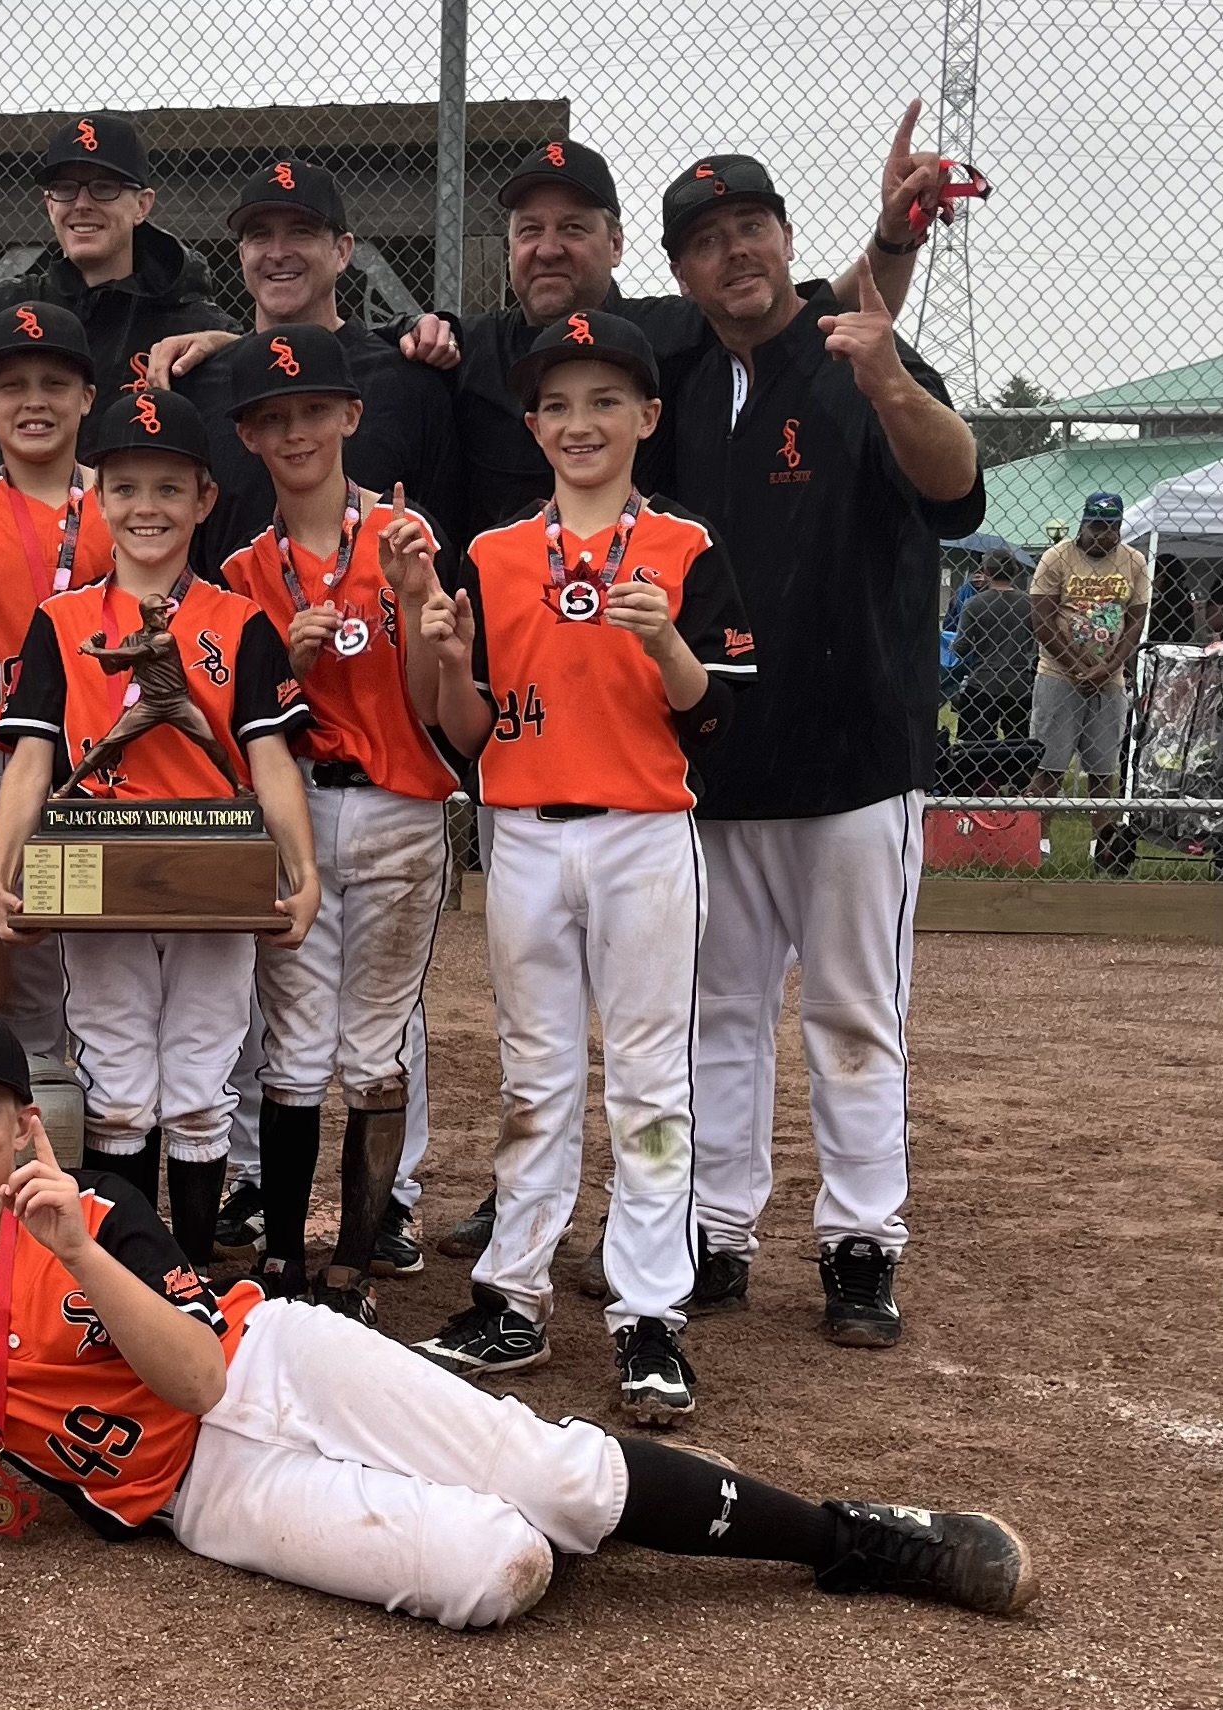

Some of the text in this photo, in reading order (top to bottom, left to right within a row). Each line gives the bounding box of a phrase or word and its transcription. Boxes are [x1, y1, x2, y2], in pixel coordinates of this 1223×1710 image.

[494, 683, 546, 742] 34
[65, 811, 97, 825] JACK
[97, 811, 143, 825] GRASBY
[145, 811, 208, 825] MEMORIAL
[207, 811, 255, 825] TROPHY
[45, 1404, 144, 1479] 49
